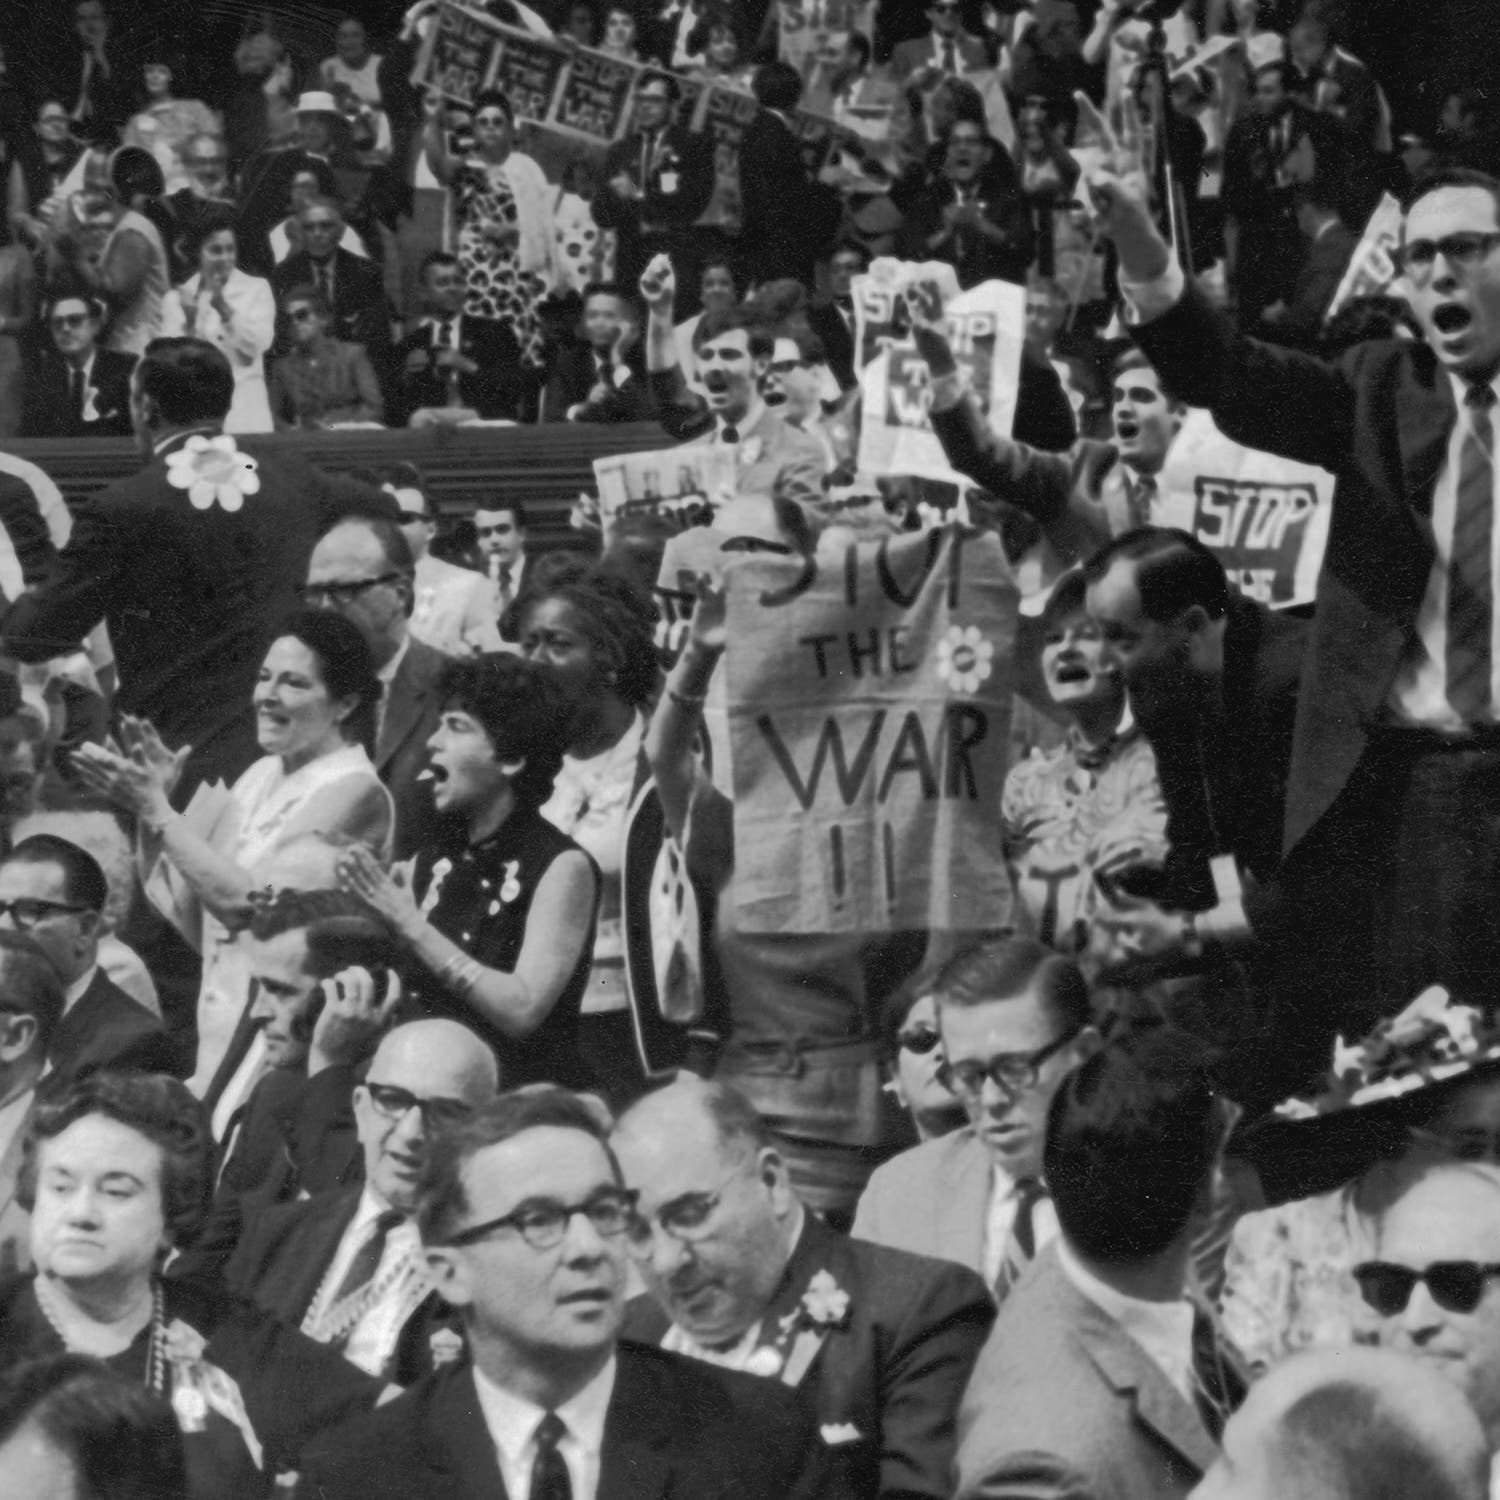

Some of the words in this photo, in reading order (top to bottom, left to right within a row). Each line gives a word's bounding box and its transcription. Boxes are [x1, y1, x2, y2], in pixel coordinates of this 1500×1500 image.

[1197, 484, 1314, 549] STOP
[799, 627, 914, 679] THE
[757, 703, 990, 811] WAR
